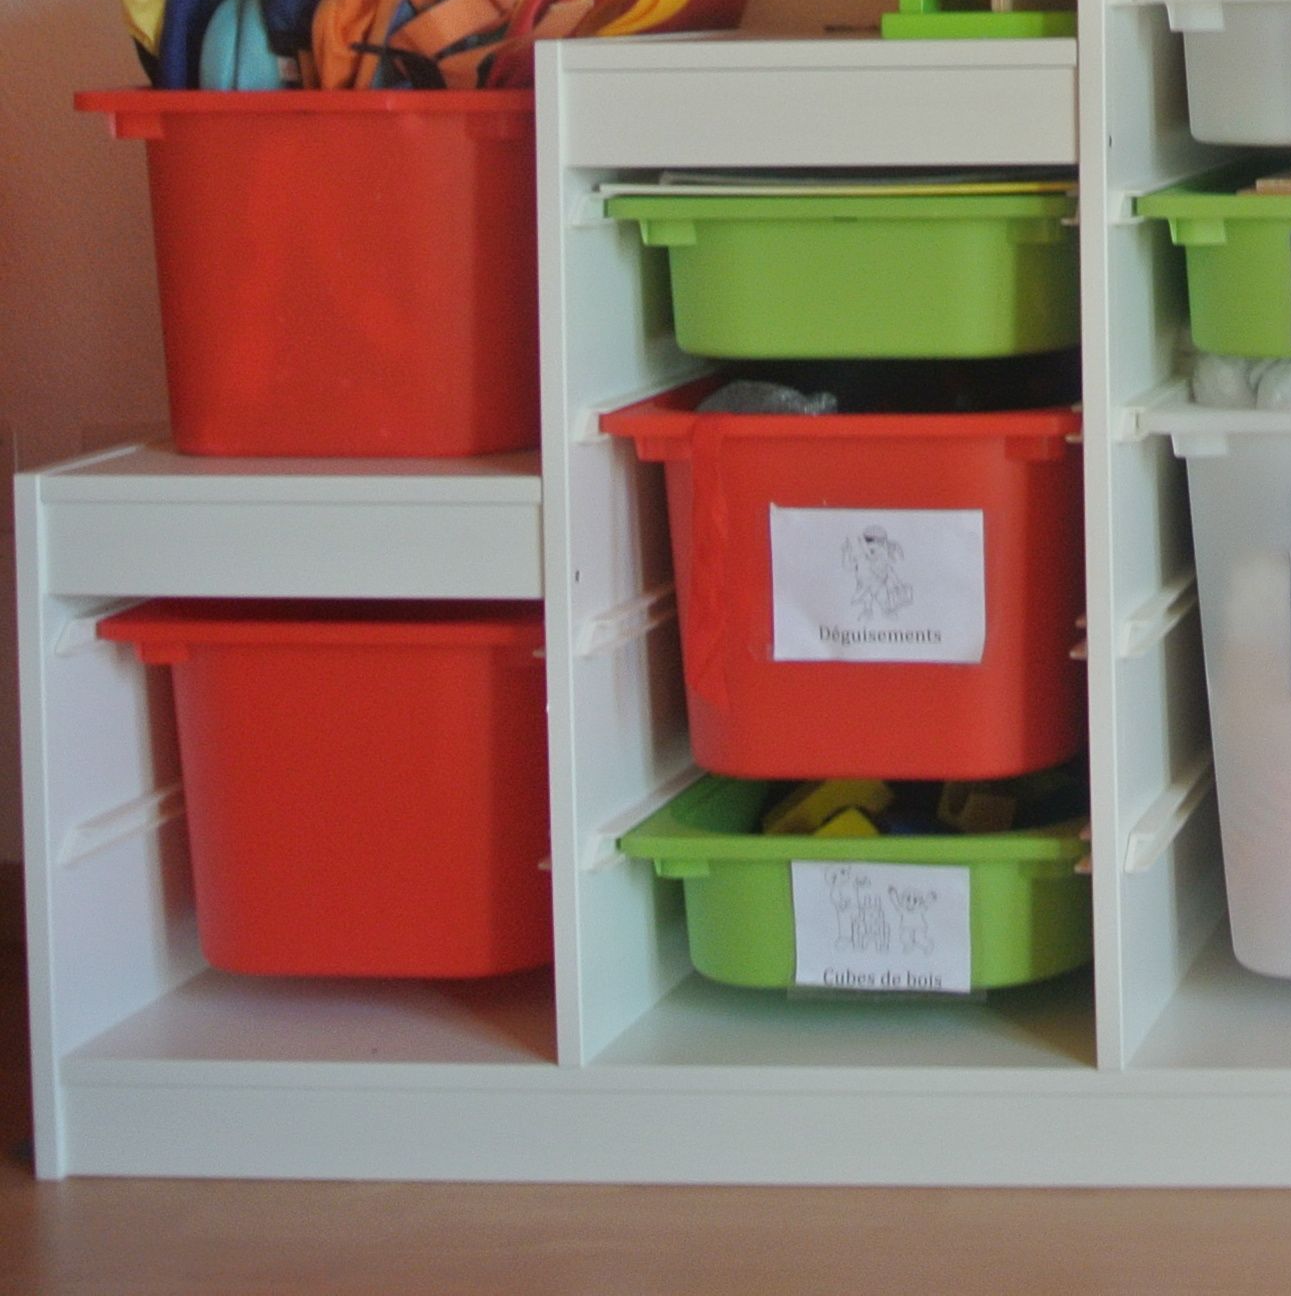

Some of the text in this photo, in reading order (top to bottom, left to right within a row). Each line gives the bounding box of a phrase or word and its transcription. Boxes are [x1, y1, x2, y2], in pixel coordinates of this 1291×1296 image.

[818, 622, 942, 646] Déguisements
[822, 966, 942, 989] Cubes de bois
